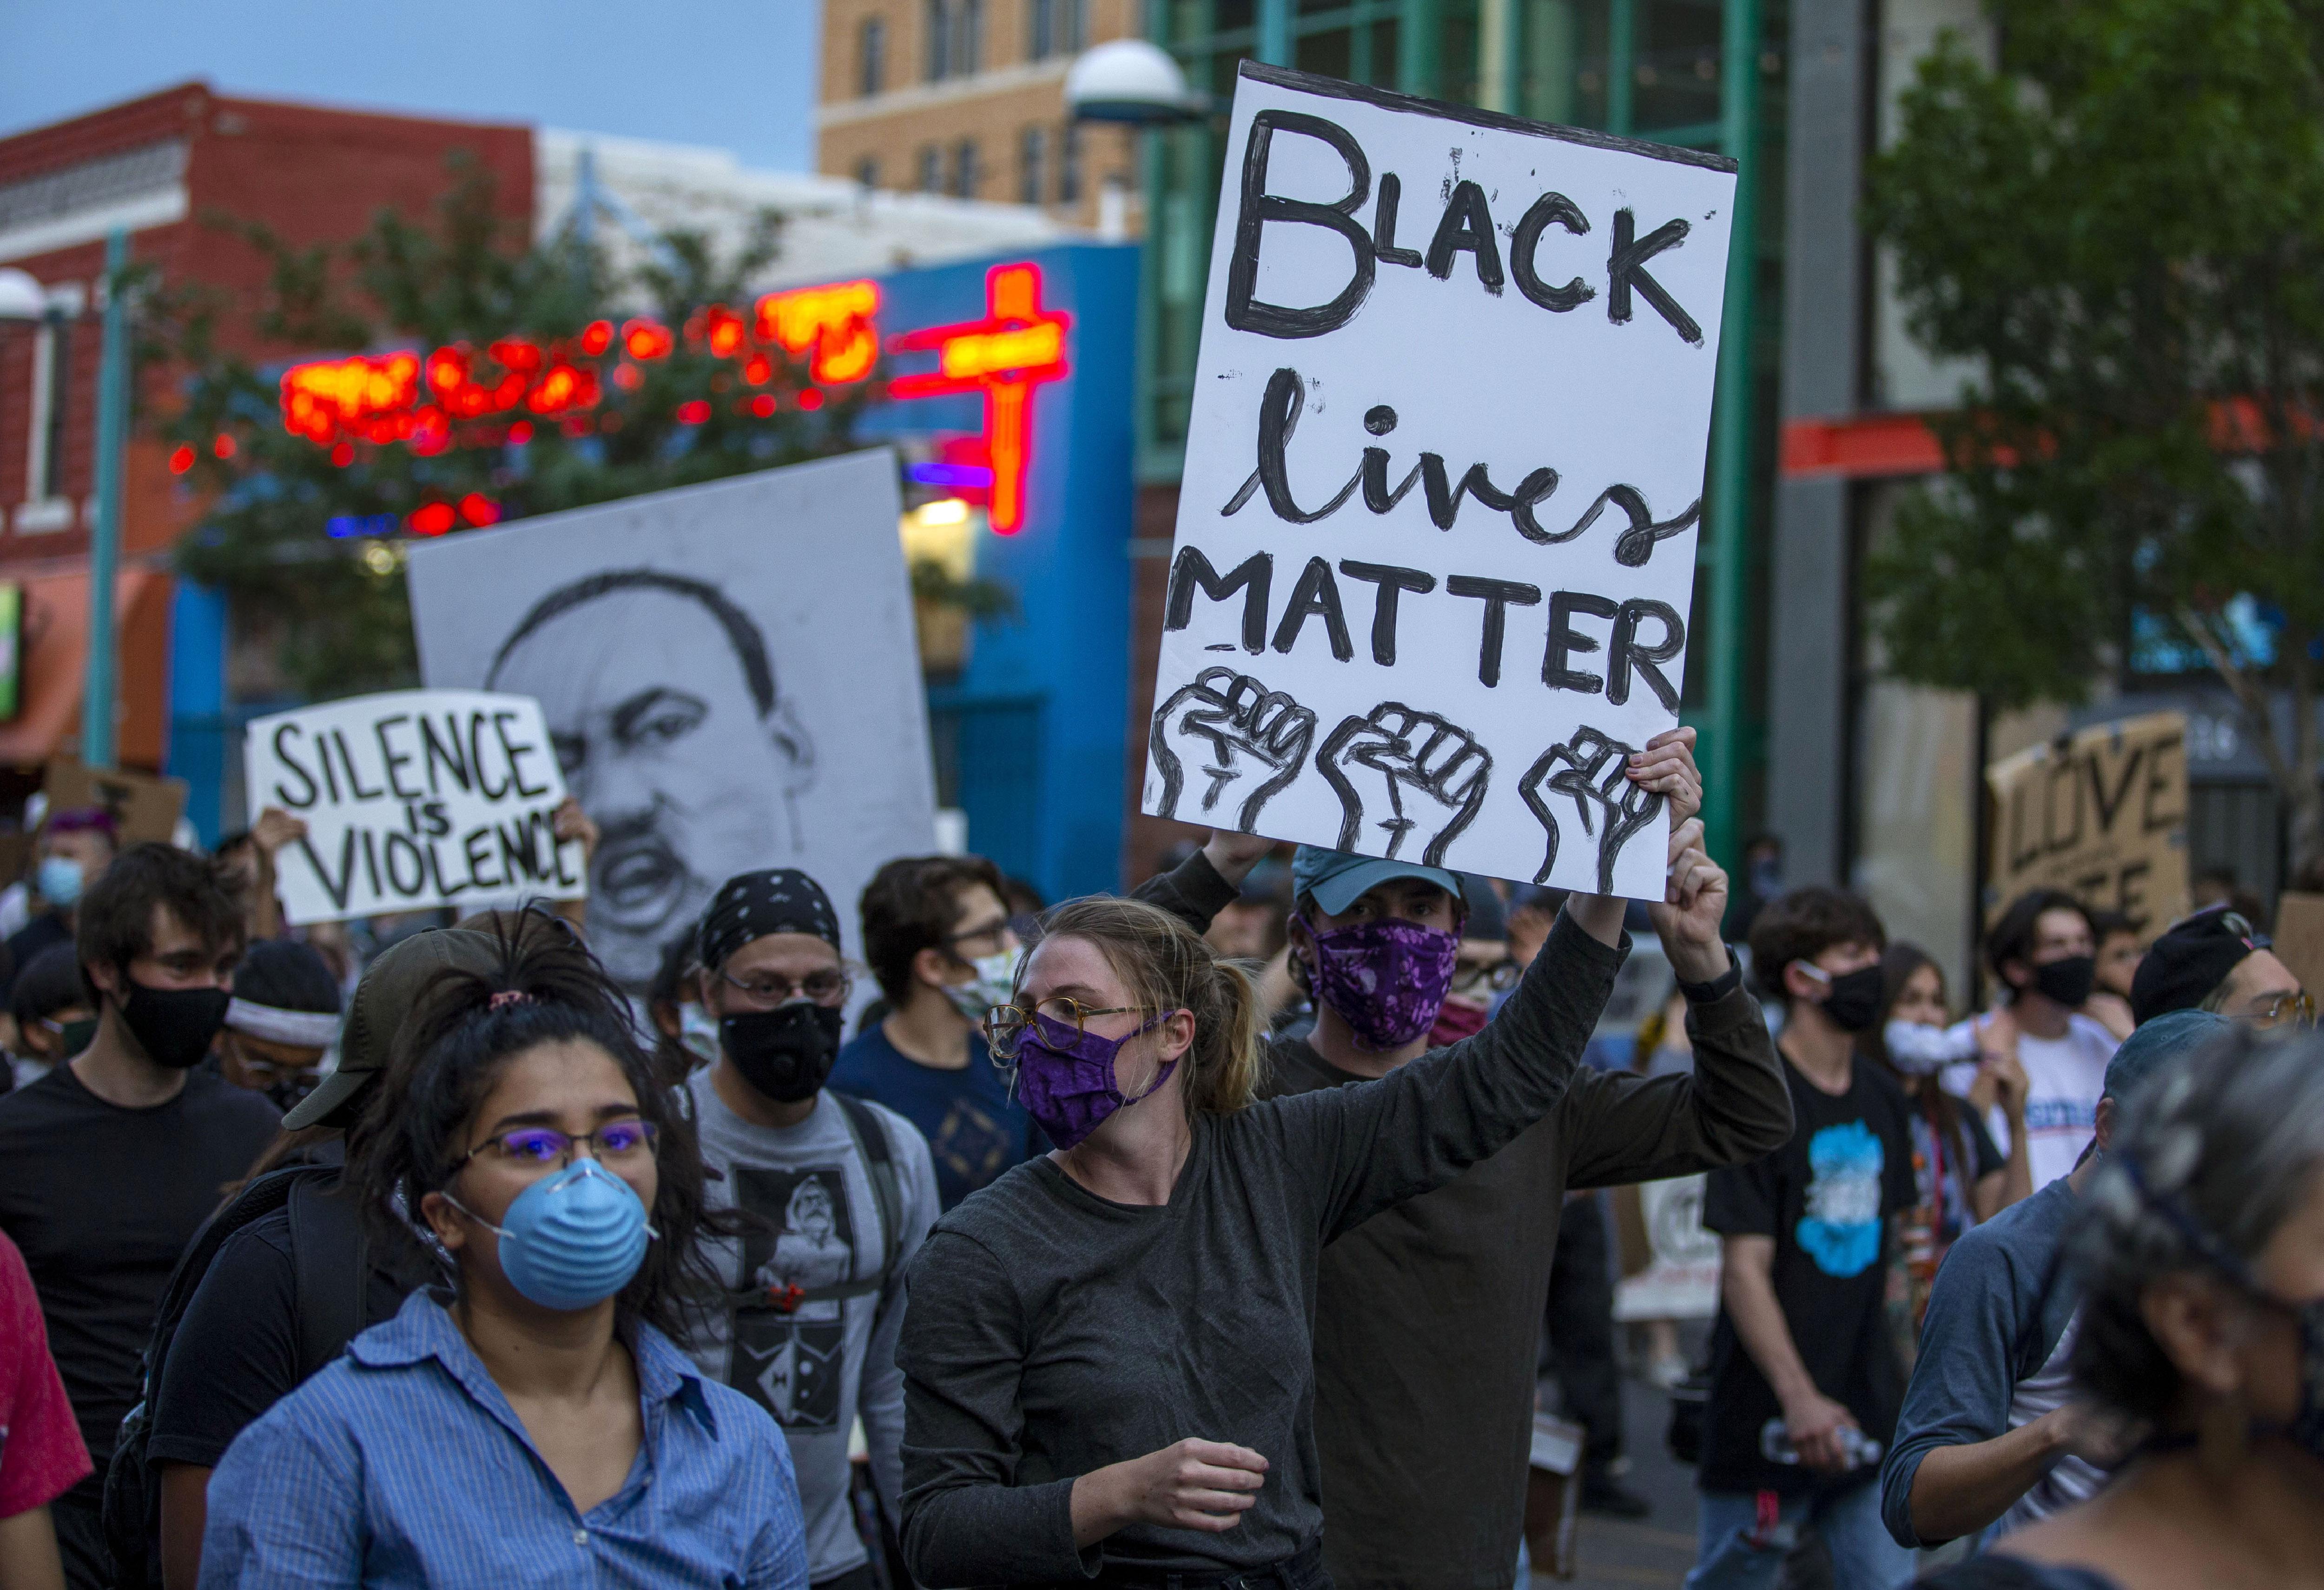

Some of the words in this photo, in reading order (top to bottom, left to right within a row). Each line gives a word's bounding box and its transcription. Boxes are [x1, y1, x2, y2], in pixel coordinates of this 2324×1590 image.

[1225, 110, 1703, 349] BLACK
[1220, 368, 1699, 567] lives
[1164, 545, 1686, 717] MATTER
[273, 711, 547, 808] SILENCE
[2009, 732, 2185, 874] LOVE
